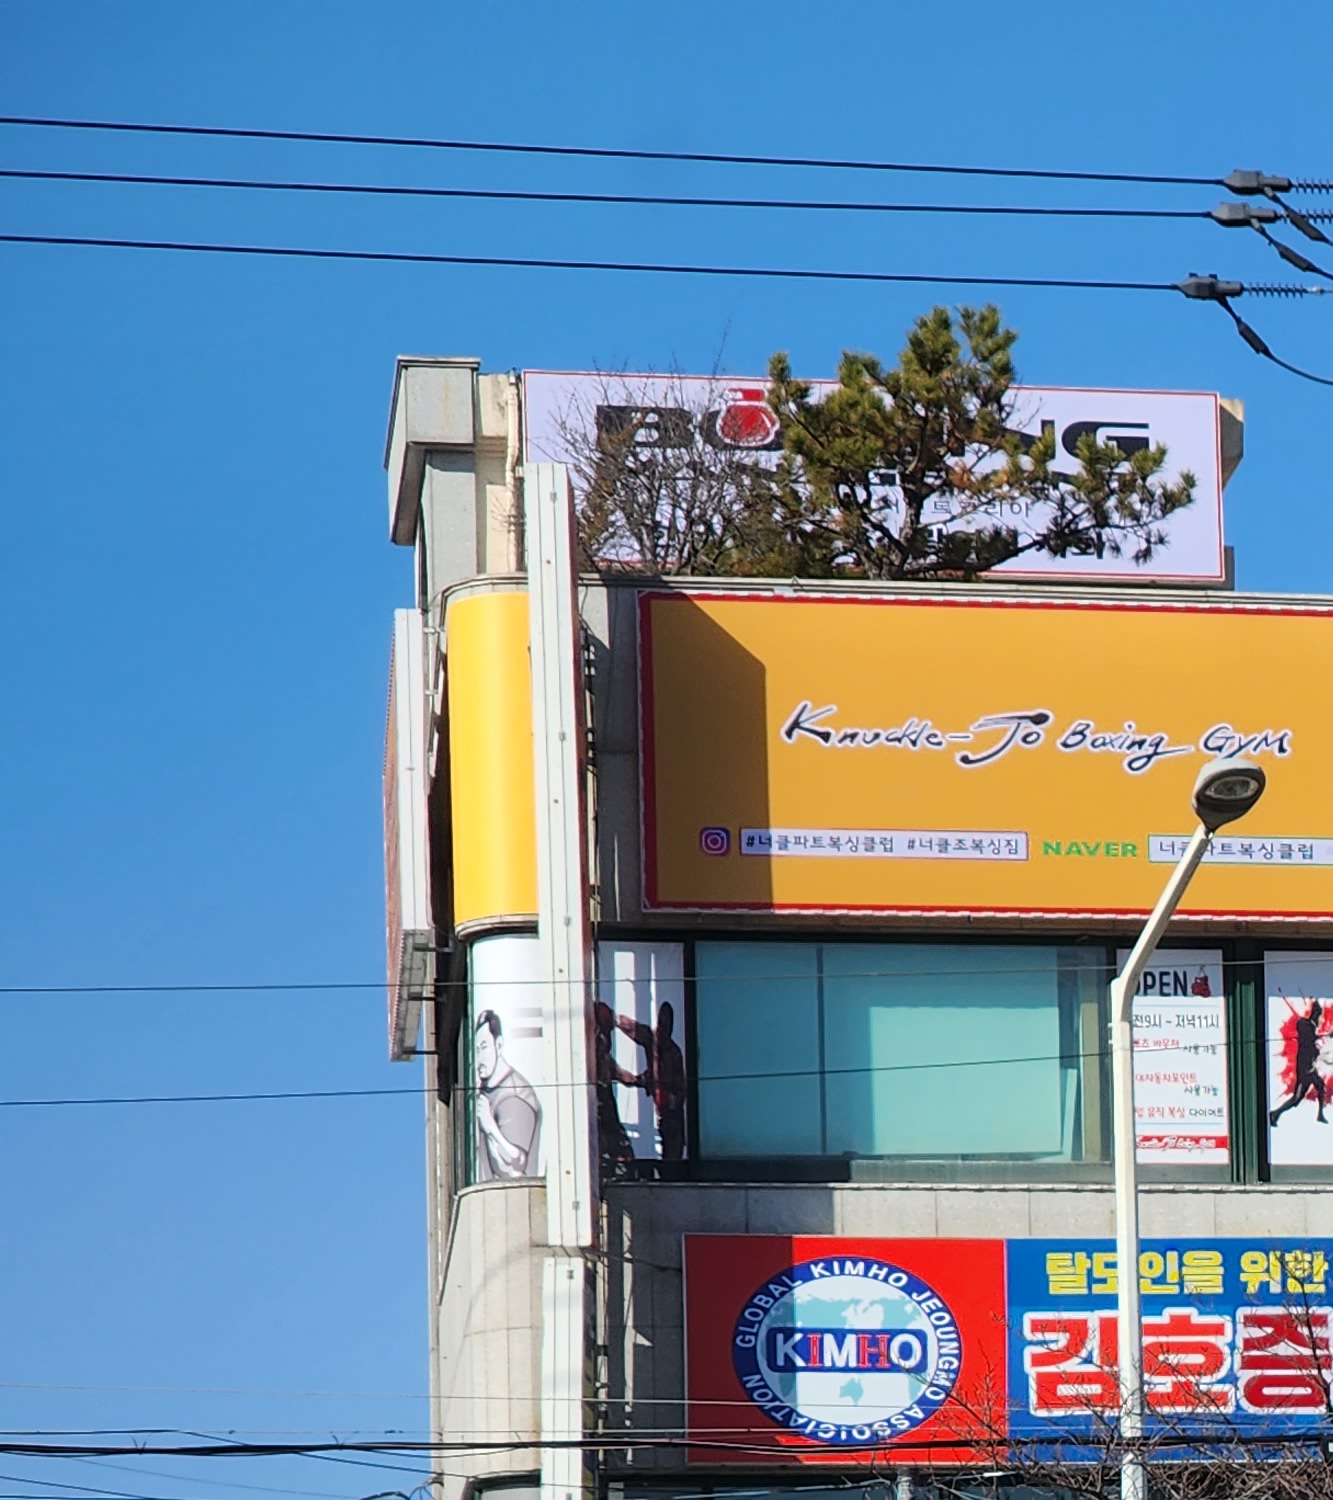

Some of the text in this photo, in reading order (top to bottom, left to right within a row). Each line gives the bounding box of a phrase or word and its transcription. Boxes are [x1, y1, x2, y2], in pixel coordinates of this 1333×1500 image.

[1059, 722, 1195, 772] Boxing
[1042, 840, 1138, 858] NAVER
[1136, 971, 1188, 998] PEN
[1240, 1249, 1328, 1297] 위한
[736, 1274, 803, 1349] GLOBAL
[809, 1259, 909, 1289] KIMHO
[774, 1331, 924, 1370] KIMHO
